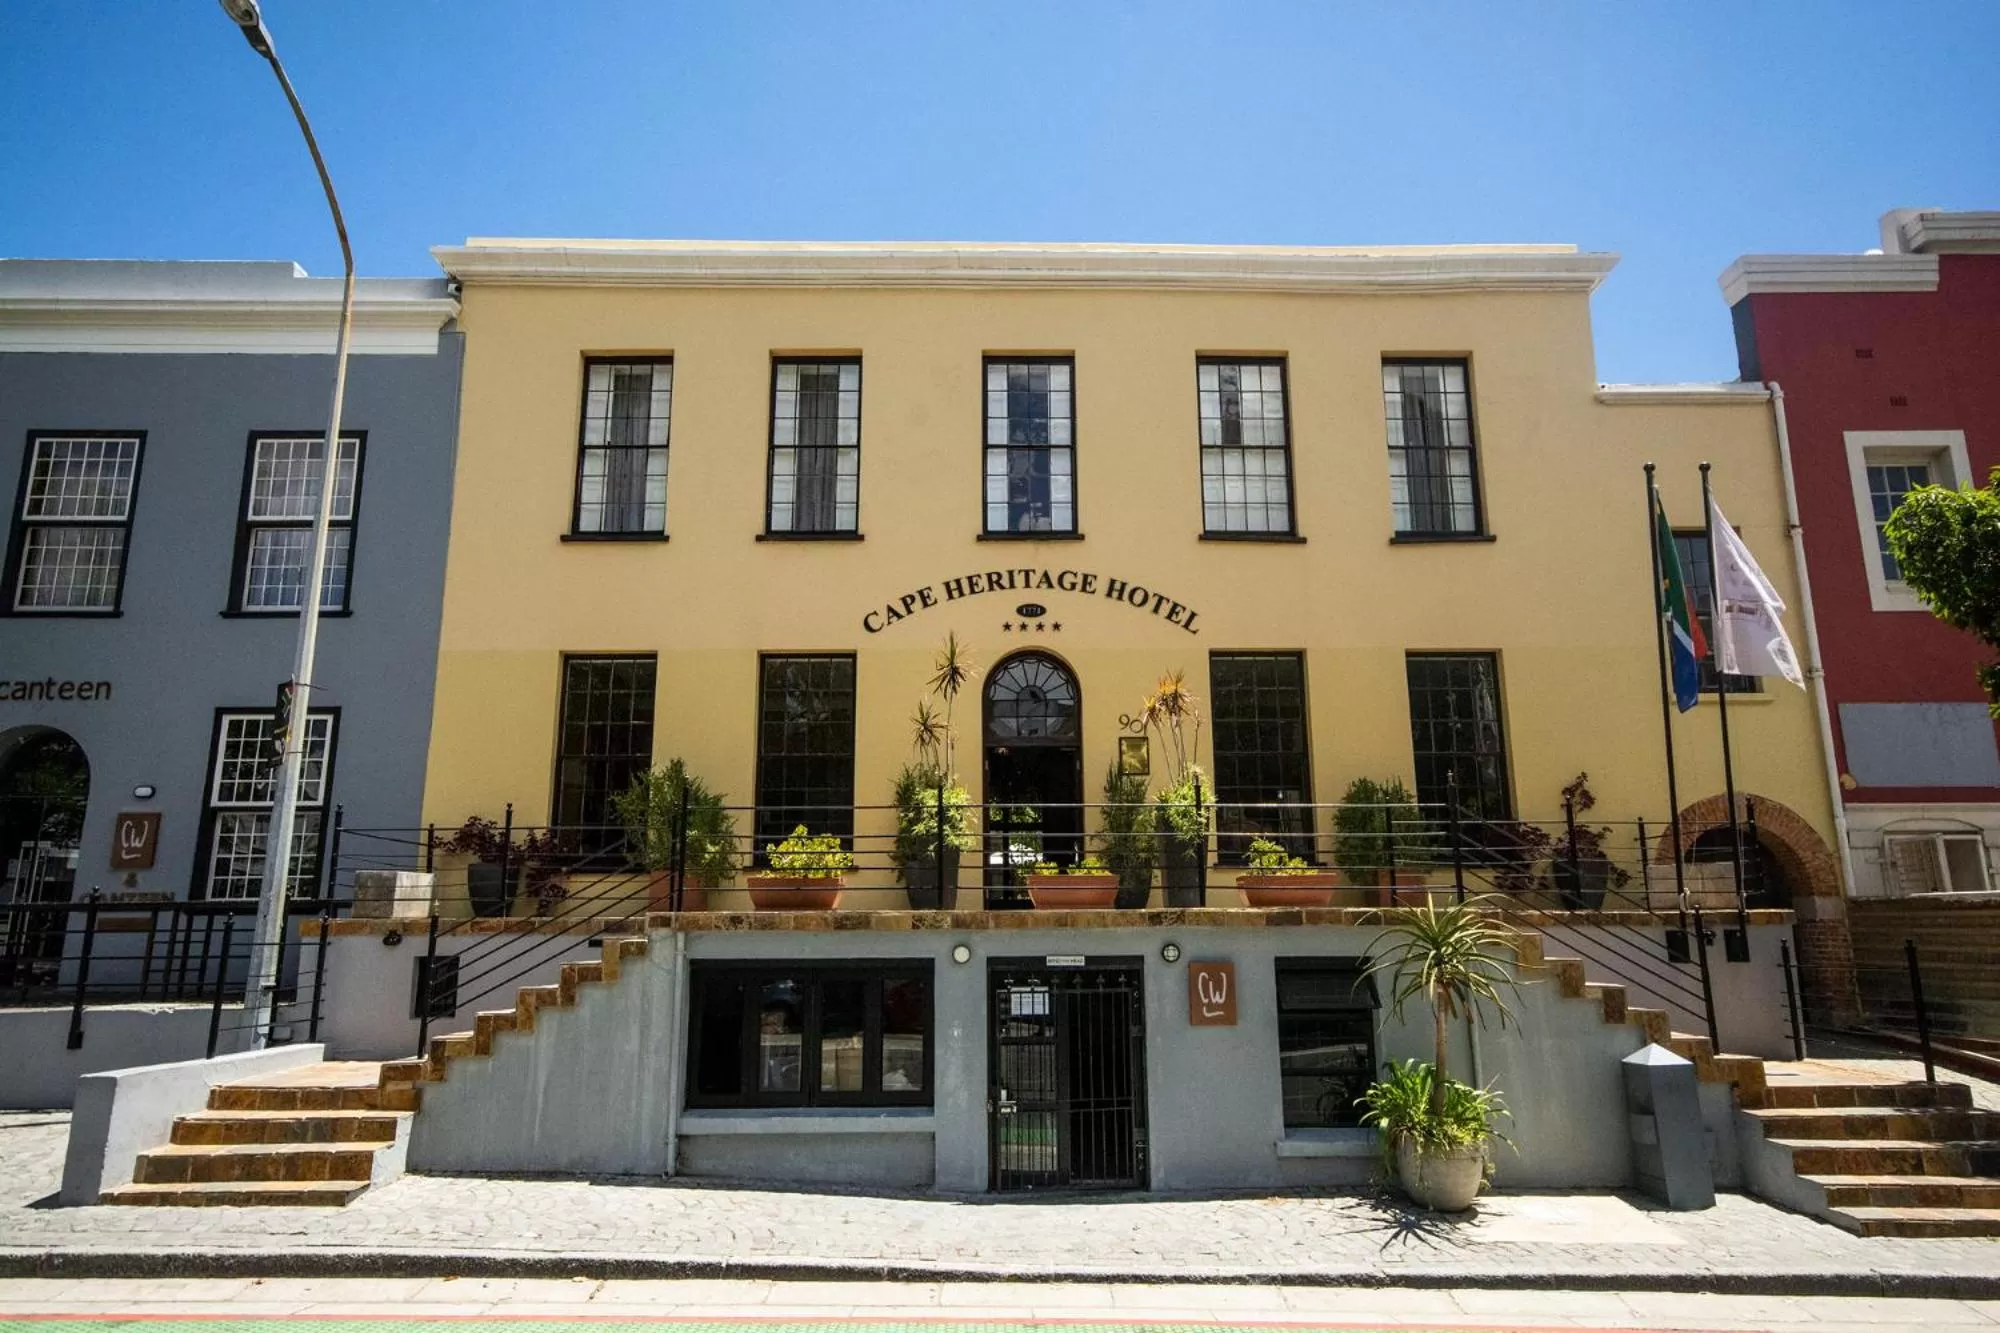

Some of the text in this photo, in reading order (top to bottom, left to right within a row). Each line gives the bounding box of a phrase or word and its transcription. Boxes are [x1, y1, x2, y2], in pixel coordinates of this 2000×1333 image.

[863, 569, 1200, 635] CAPE HERITAGE HOTEL
[1118, 714, 1143, 733] 90
